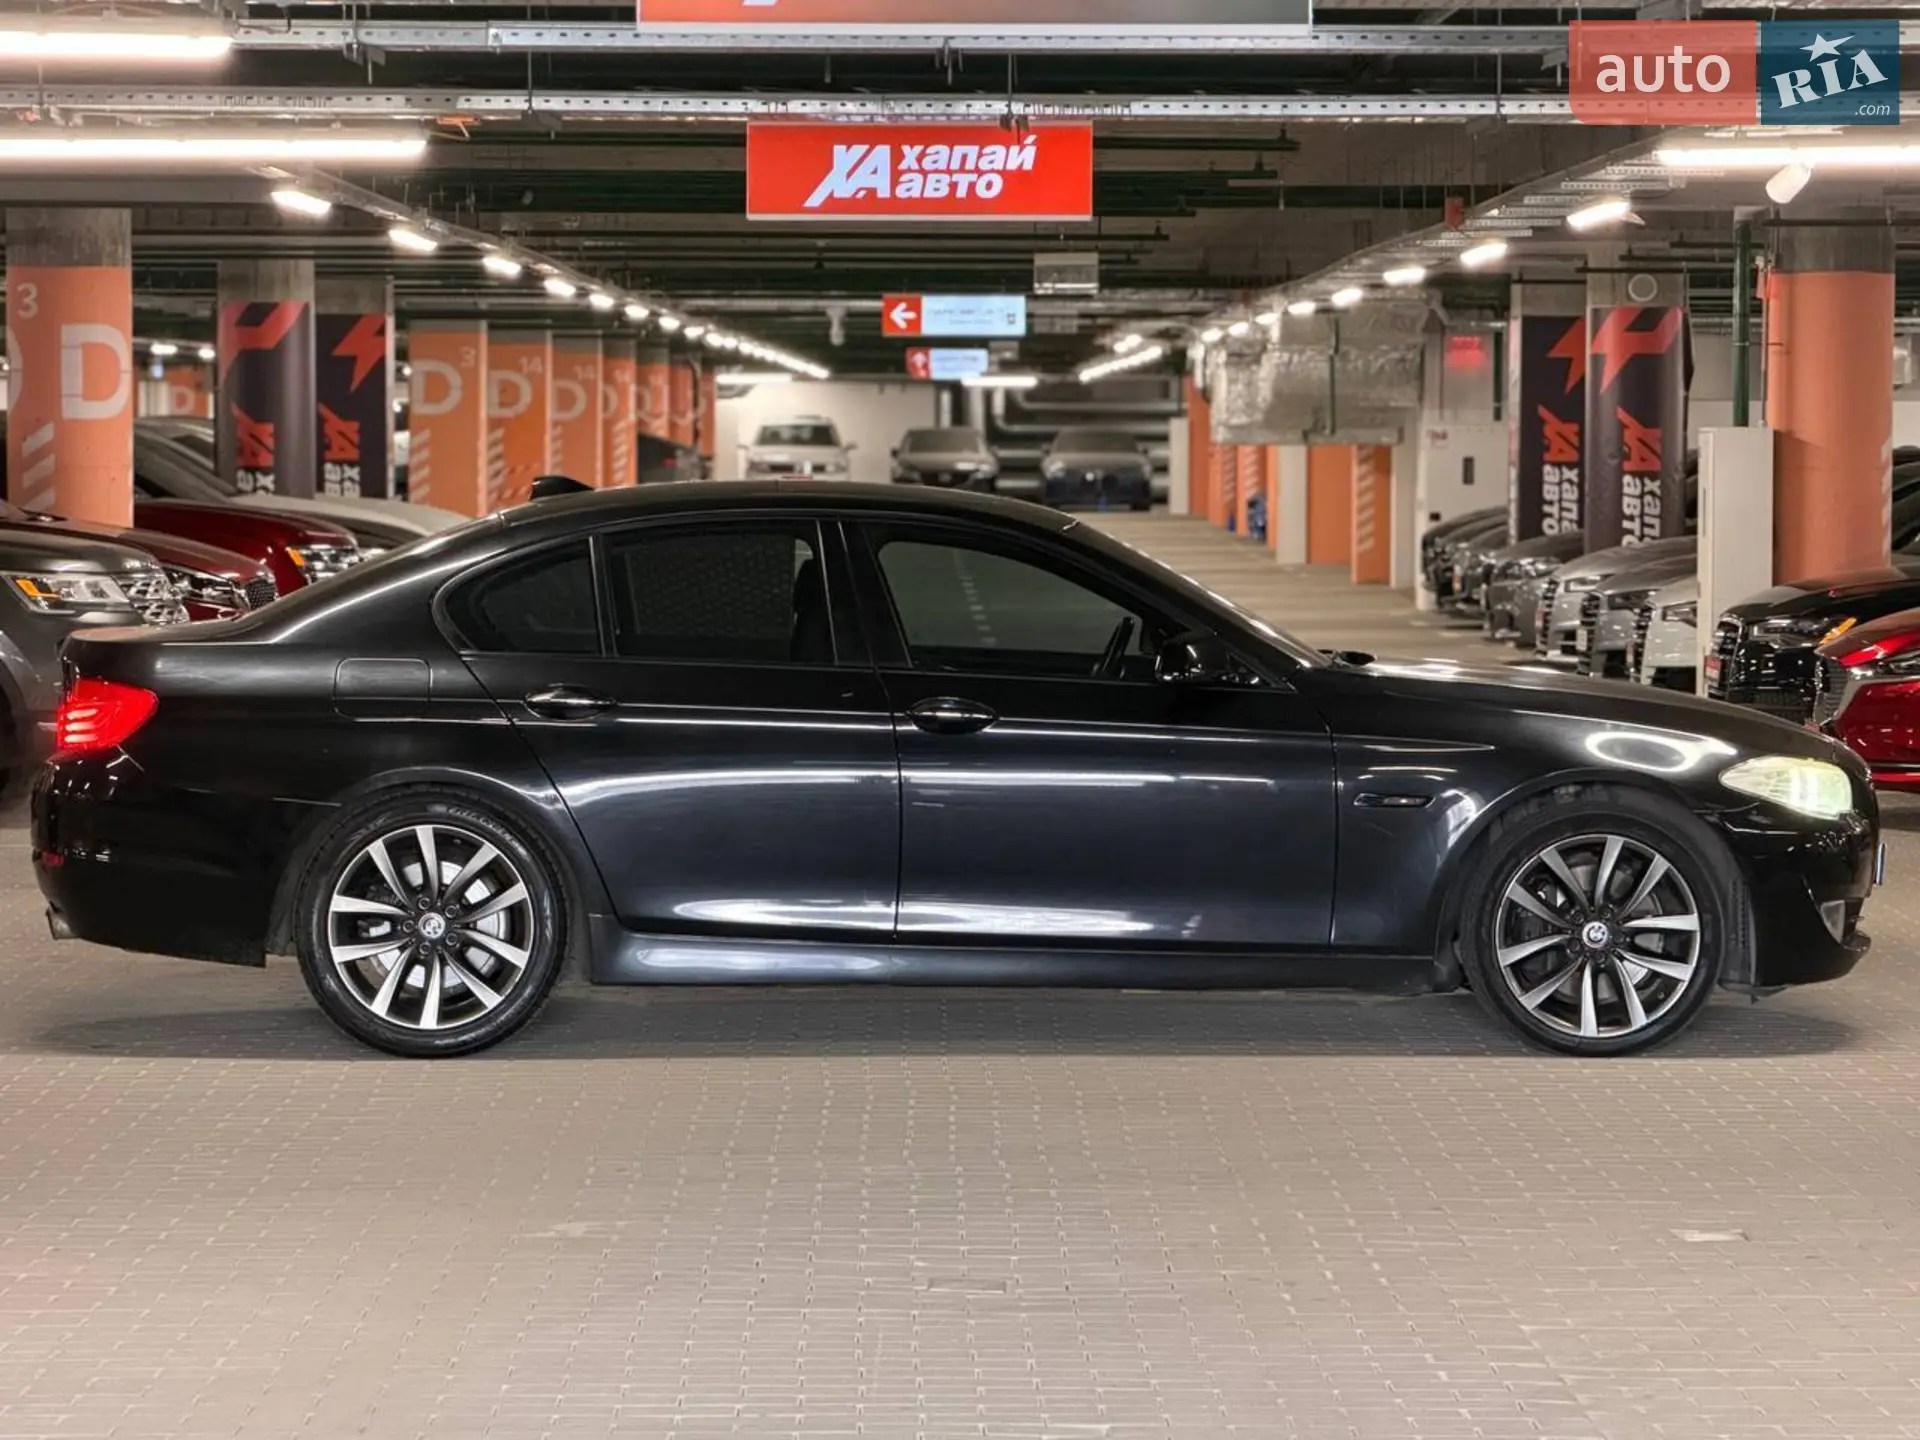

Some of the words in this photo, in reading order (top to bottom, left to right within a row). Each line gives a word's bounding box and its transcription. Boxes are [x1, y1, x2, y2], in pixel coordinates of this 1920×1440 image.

[897, 134, 1038, 170] хапай
[895, 173, 1004, 199] авто
[17, 282, 39, 319] 3
[61, 323, 131, 420] D
[411, 359, 463, 416] D
[489, 369, 533, 418] D
[1541, 464, 1560, 536] авто
